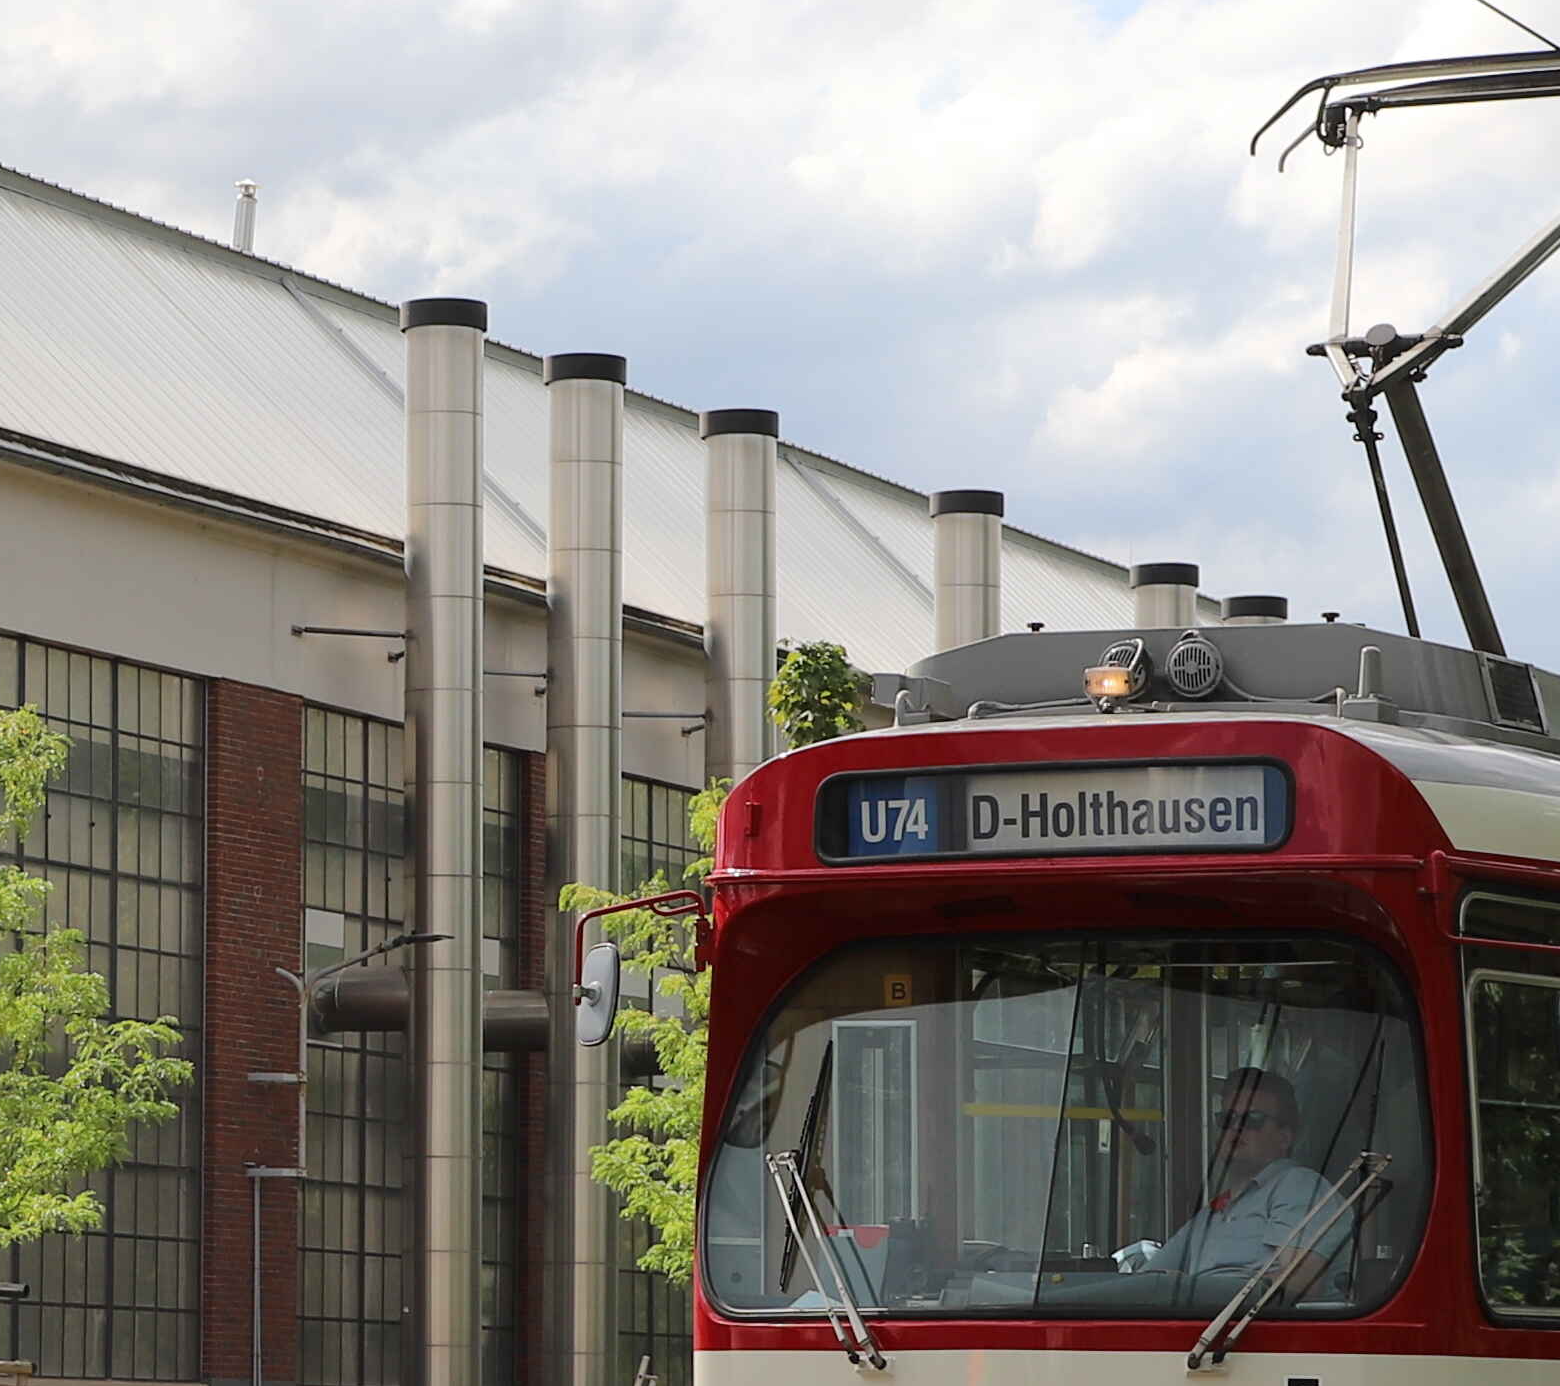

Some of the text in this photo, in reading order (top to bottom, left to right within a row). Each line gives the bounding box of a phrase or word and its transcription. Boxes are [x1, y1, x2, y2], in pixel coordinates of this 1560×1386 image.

[860, 791, 1258, 843] U74 D-Holthausen
[891, 982, 906, 1000] B
